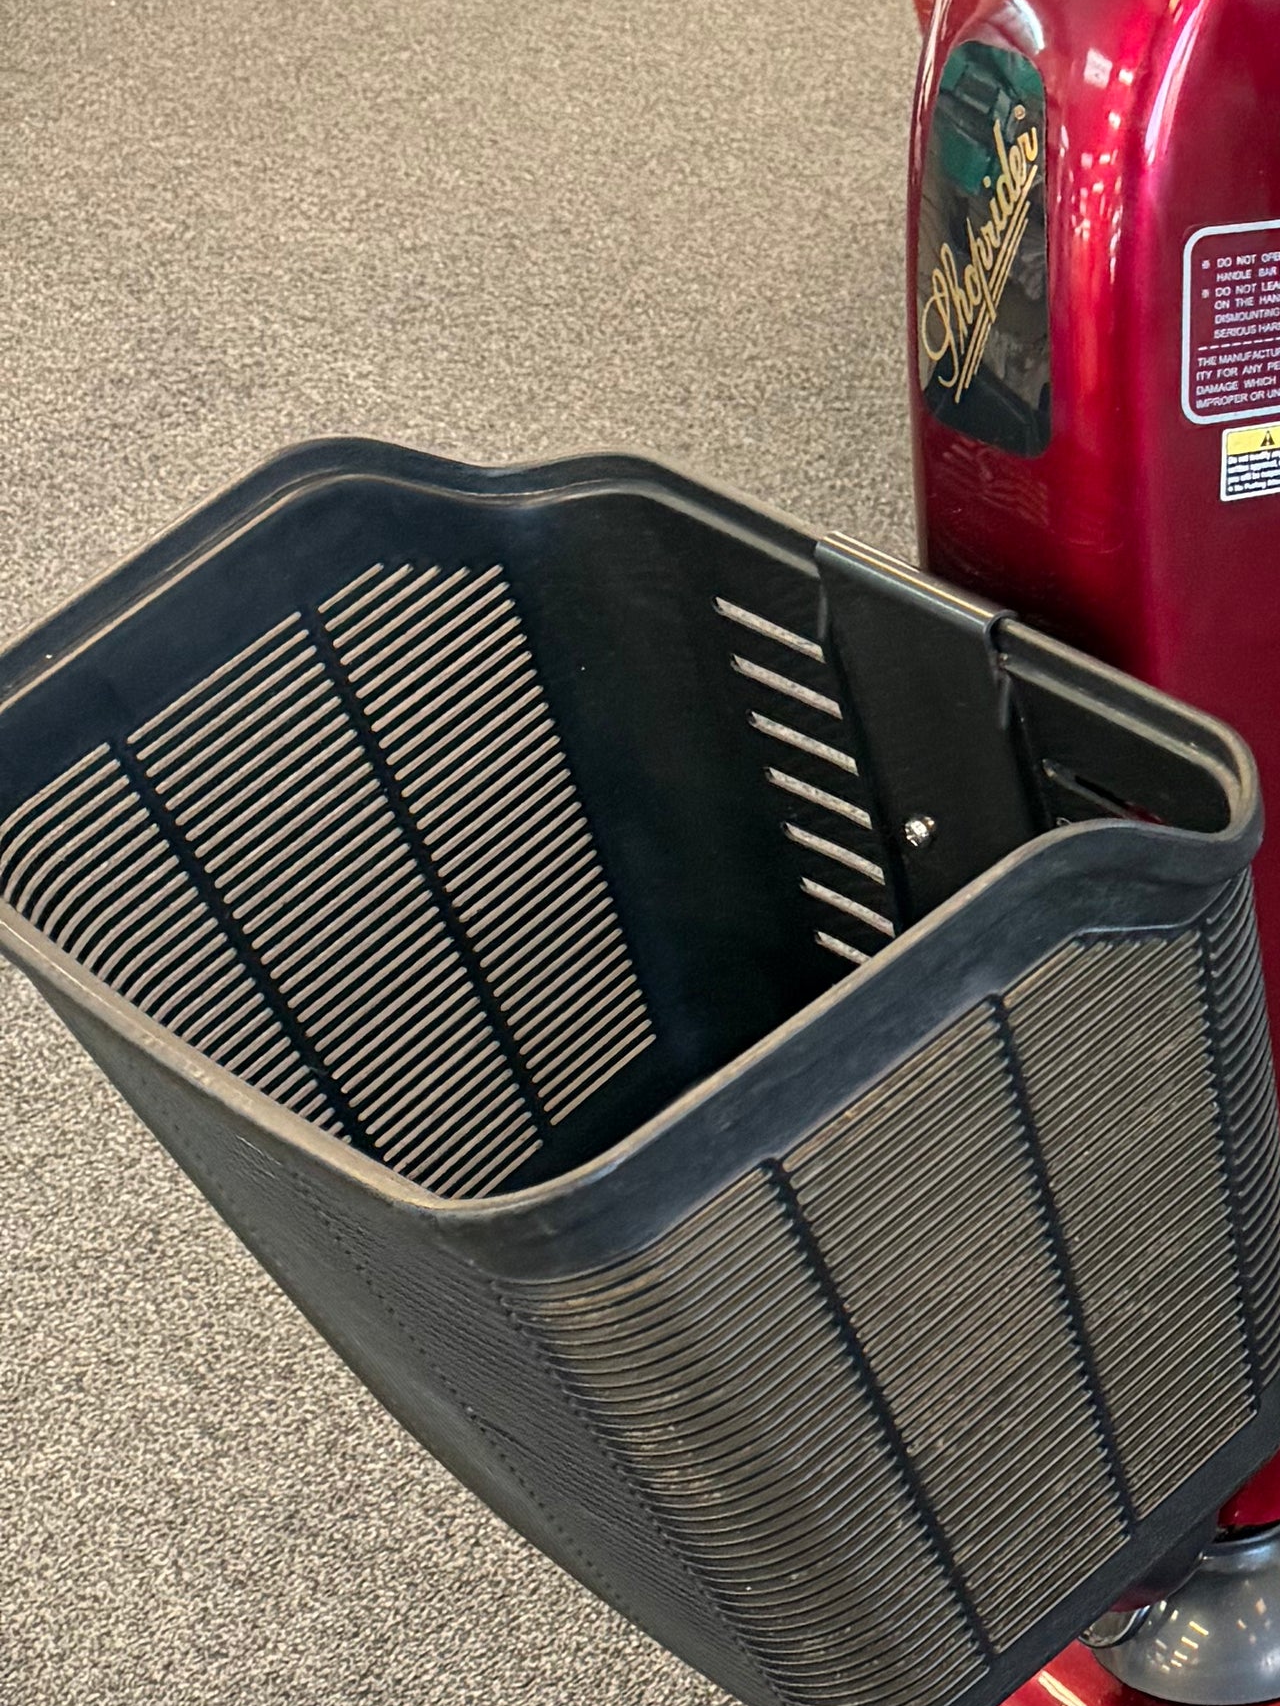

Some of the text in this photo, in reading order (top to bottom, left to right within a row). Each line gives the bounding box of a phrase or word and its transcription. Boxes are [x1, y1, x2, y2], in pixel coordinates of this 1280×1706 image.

[921, 117, 1039, 390] Shoprider
[1217, 257, 1232, 268] DO
[1236, 254, 1257, 265] NOT
[1216, 269, 1252, 282] HANDLE
[1215, 287, 1231, 297] DO
[1235, 283, 1257, 294] NOT
[1214, 299, 1230, 310] ON
[1234, 296, 1254, 307] THE
[1214, 307, 1280, 324] DISMOUNTING
[1214, 325, 1257, 339] SERIOUS
[1198, 356, 1217, 367] THE
[1217, 367, 1238, 378] FOR
[1242, 363, 1263, 375] ANY
[1196, 381, 1239, 396] DAMAGE
[1244, 376, 1276, 389] WHICH
[1196, 393, 1248, 409] IMPROPER
[1249, 390, 1265, 401] OR
